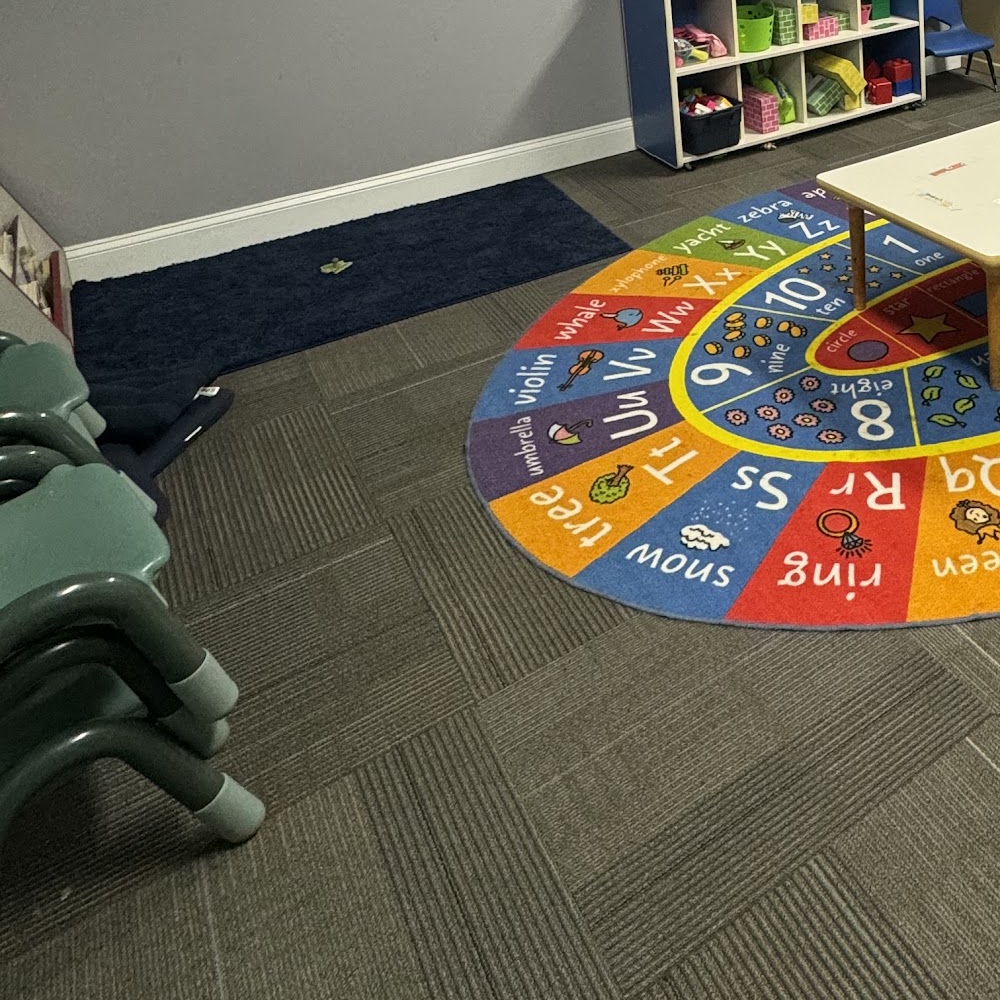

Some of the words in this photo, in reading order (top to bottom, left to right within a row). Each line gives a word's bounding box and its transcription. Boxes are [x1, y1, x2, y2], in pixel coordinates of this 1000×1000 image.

[737, 199, 793, 224] zebra
[672, 222, 732, 255] yacht
[788, 219, 841, 240] Zz
[882, 234, 919, 254] 1
[733, 239, 787, 262] Yy
[914, 251, 945, 267] one
[608, 254, 669, 295] xylophone
[682, 267, 742, 297] Xx
[765, 277, 827, 311] 10
[815, 297, 847, 318] ten
[882, 298, 912, 317] star
[554, 299, 607, 342] whale
[641, 300, 696, 335] Ww
[826, 328, 858, 354] circle
[602, 348, 657, 382] Vv
[690, 362, 753, 386] 9
[760, 343, 790, 375] nine
[508, 353, 557, 406] violin
[829, 378, 894, 399] eight
[602, 390, 659, 441] Uu
[850, 398, 895, 442] 8
[509, 415, 545, 477] umbrella
[641, 436, 700, 486] Tt
[731, 465, 793, 511] Ss
[829, 471, 907, 511] Rr
[529, 484, 613, 549] tree
[624, 542, 736, 588] snow
[776, 550, 882, 602] ring
